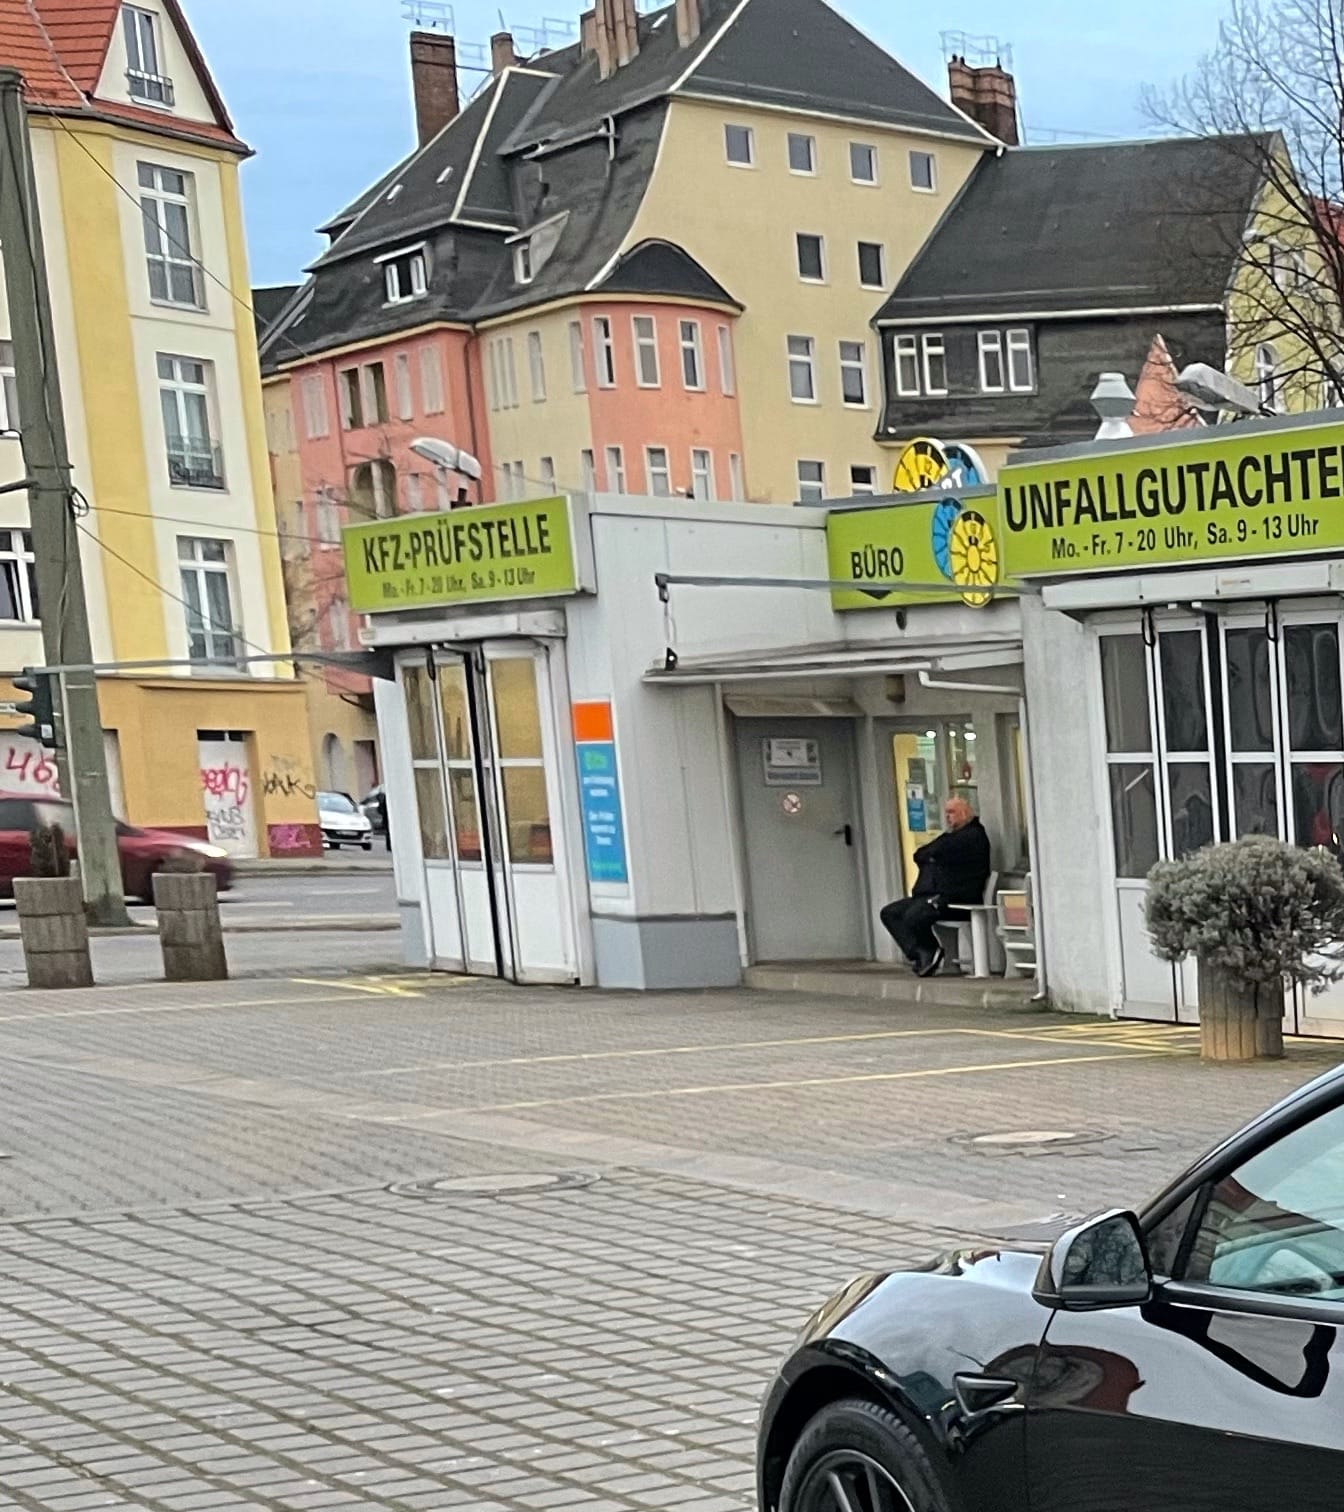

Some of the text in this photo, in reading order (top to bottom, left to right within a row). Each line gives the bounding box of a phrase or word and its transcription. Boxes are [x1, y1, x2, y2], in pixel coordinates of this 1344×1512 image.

[362, 514, 552, 573] KFZ-PRÜFSTELLE
[1115, 532, 1124, 554] 7
[1137, 528, 1156, 552] 20
[1164, 525, 1198, 550] Uhr,
[1207, 522, 1232, 545] Sa.
[1237, 519, 1247, 542] 9
[1263, 515, 1282, 540] 13
[1287, 513, 1319, 537] Uhr
[851, 543, 904, 579] BÜRO
